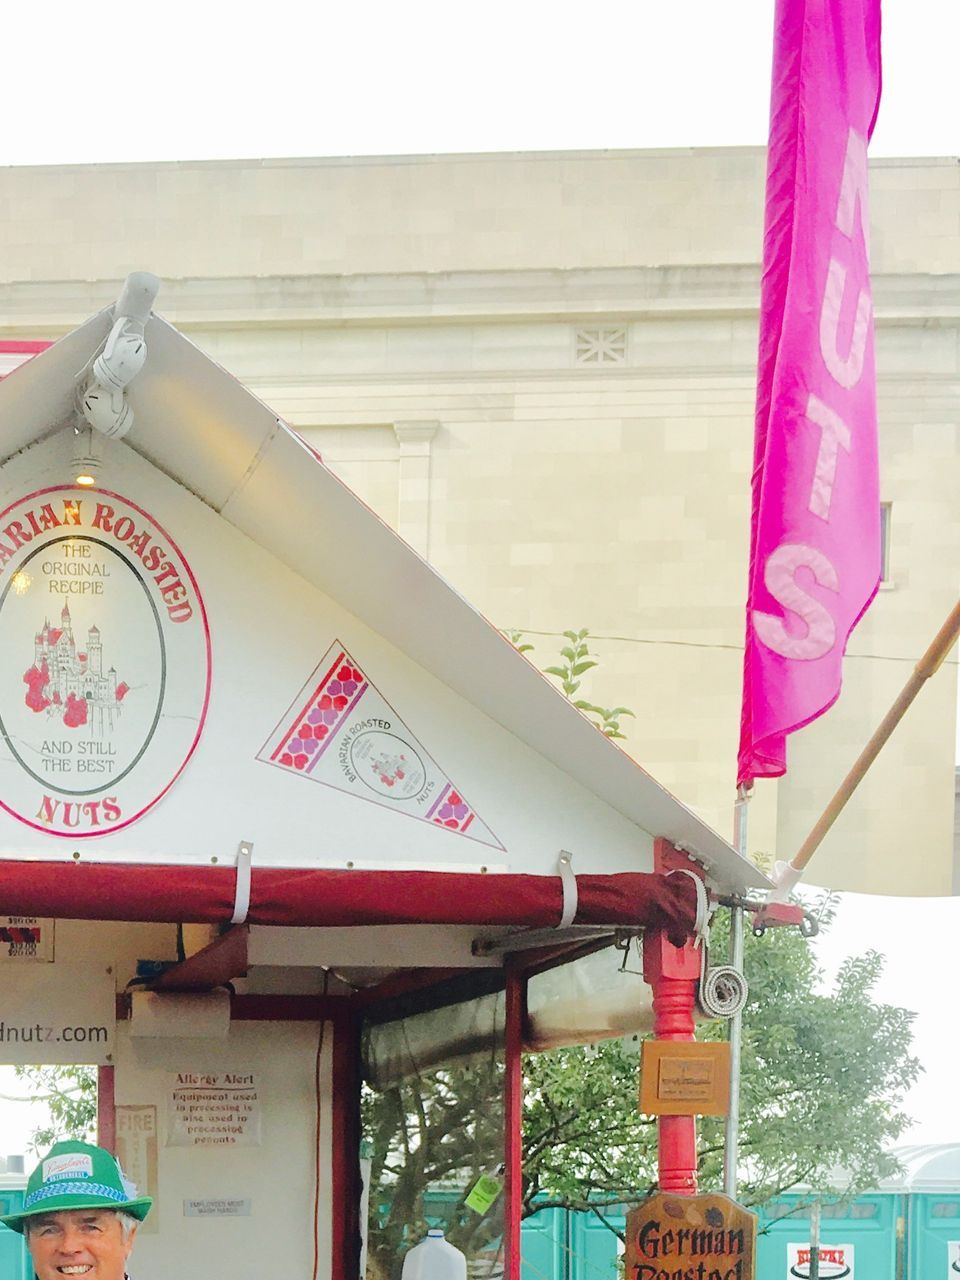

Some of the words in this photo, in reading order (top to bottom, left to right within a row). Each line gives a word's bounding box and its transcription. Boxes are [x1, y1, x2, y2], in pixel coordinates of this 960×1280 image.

[61, 544, 91, 558] THE
[42, 561, 110, 577] ORIGINAL
[91, 502, 193, 623] ROASTED
[48, 579, 104, 595] RECIPIE
[40, 740, 73, 755] AND
[77, 741, 117, 756] STILL
[339, 735, 357, 783] BAVARIAN
[350, 718, 391, 738] ROASTED
[41, 758, 71, 772] THE
[76, 759, 116, 773] BEST
[416, 780, 435, 805] NUTS
[35, 794, 122, 827] NUTS
[175, 1073, 219, 1086] Allergy
[223, 1073, 254, 1085] Alert
[172, 1091, 228, 1102] Equipment
[232, 1092, 257, 1101] used
[189, 1104, 240, 1113] processing
[118, 1114, 153, 1131] FIRE
[208, 1114, 233, 1122] used
[187, 1125, 243, 1134] processing
[638, 1219, 745, 1258] German
